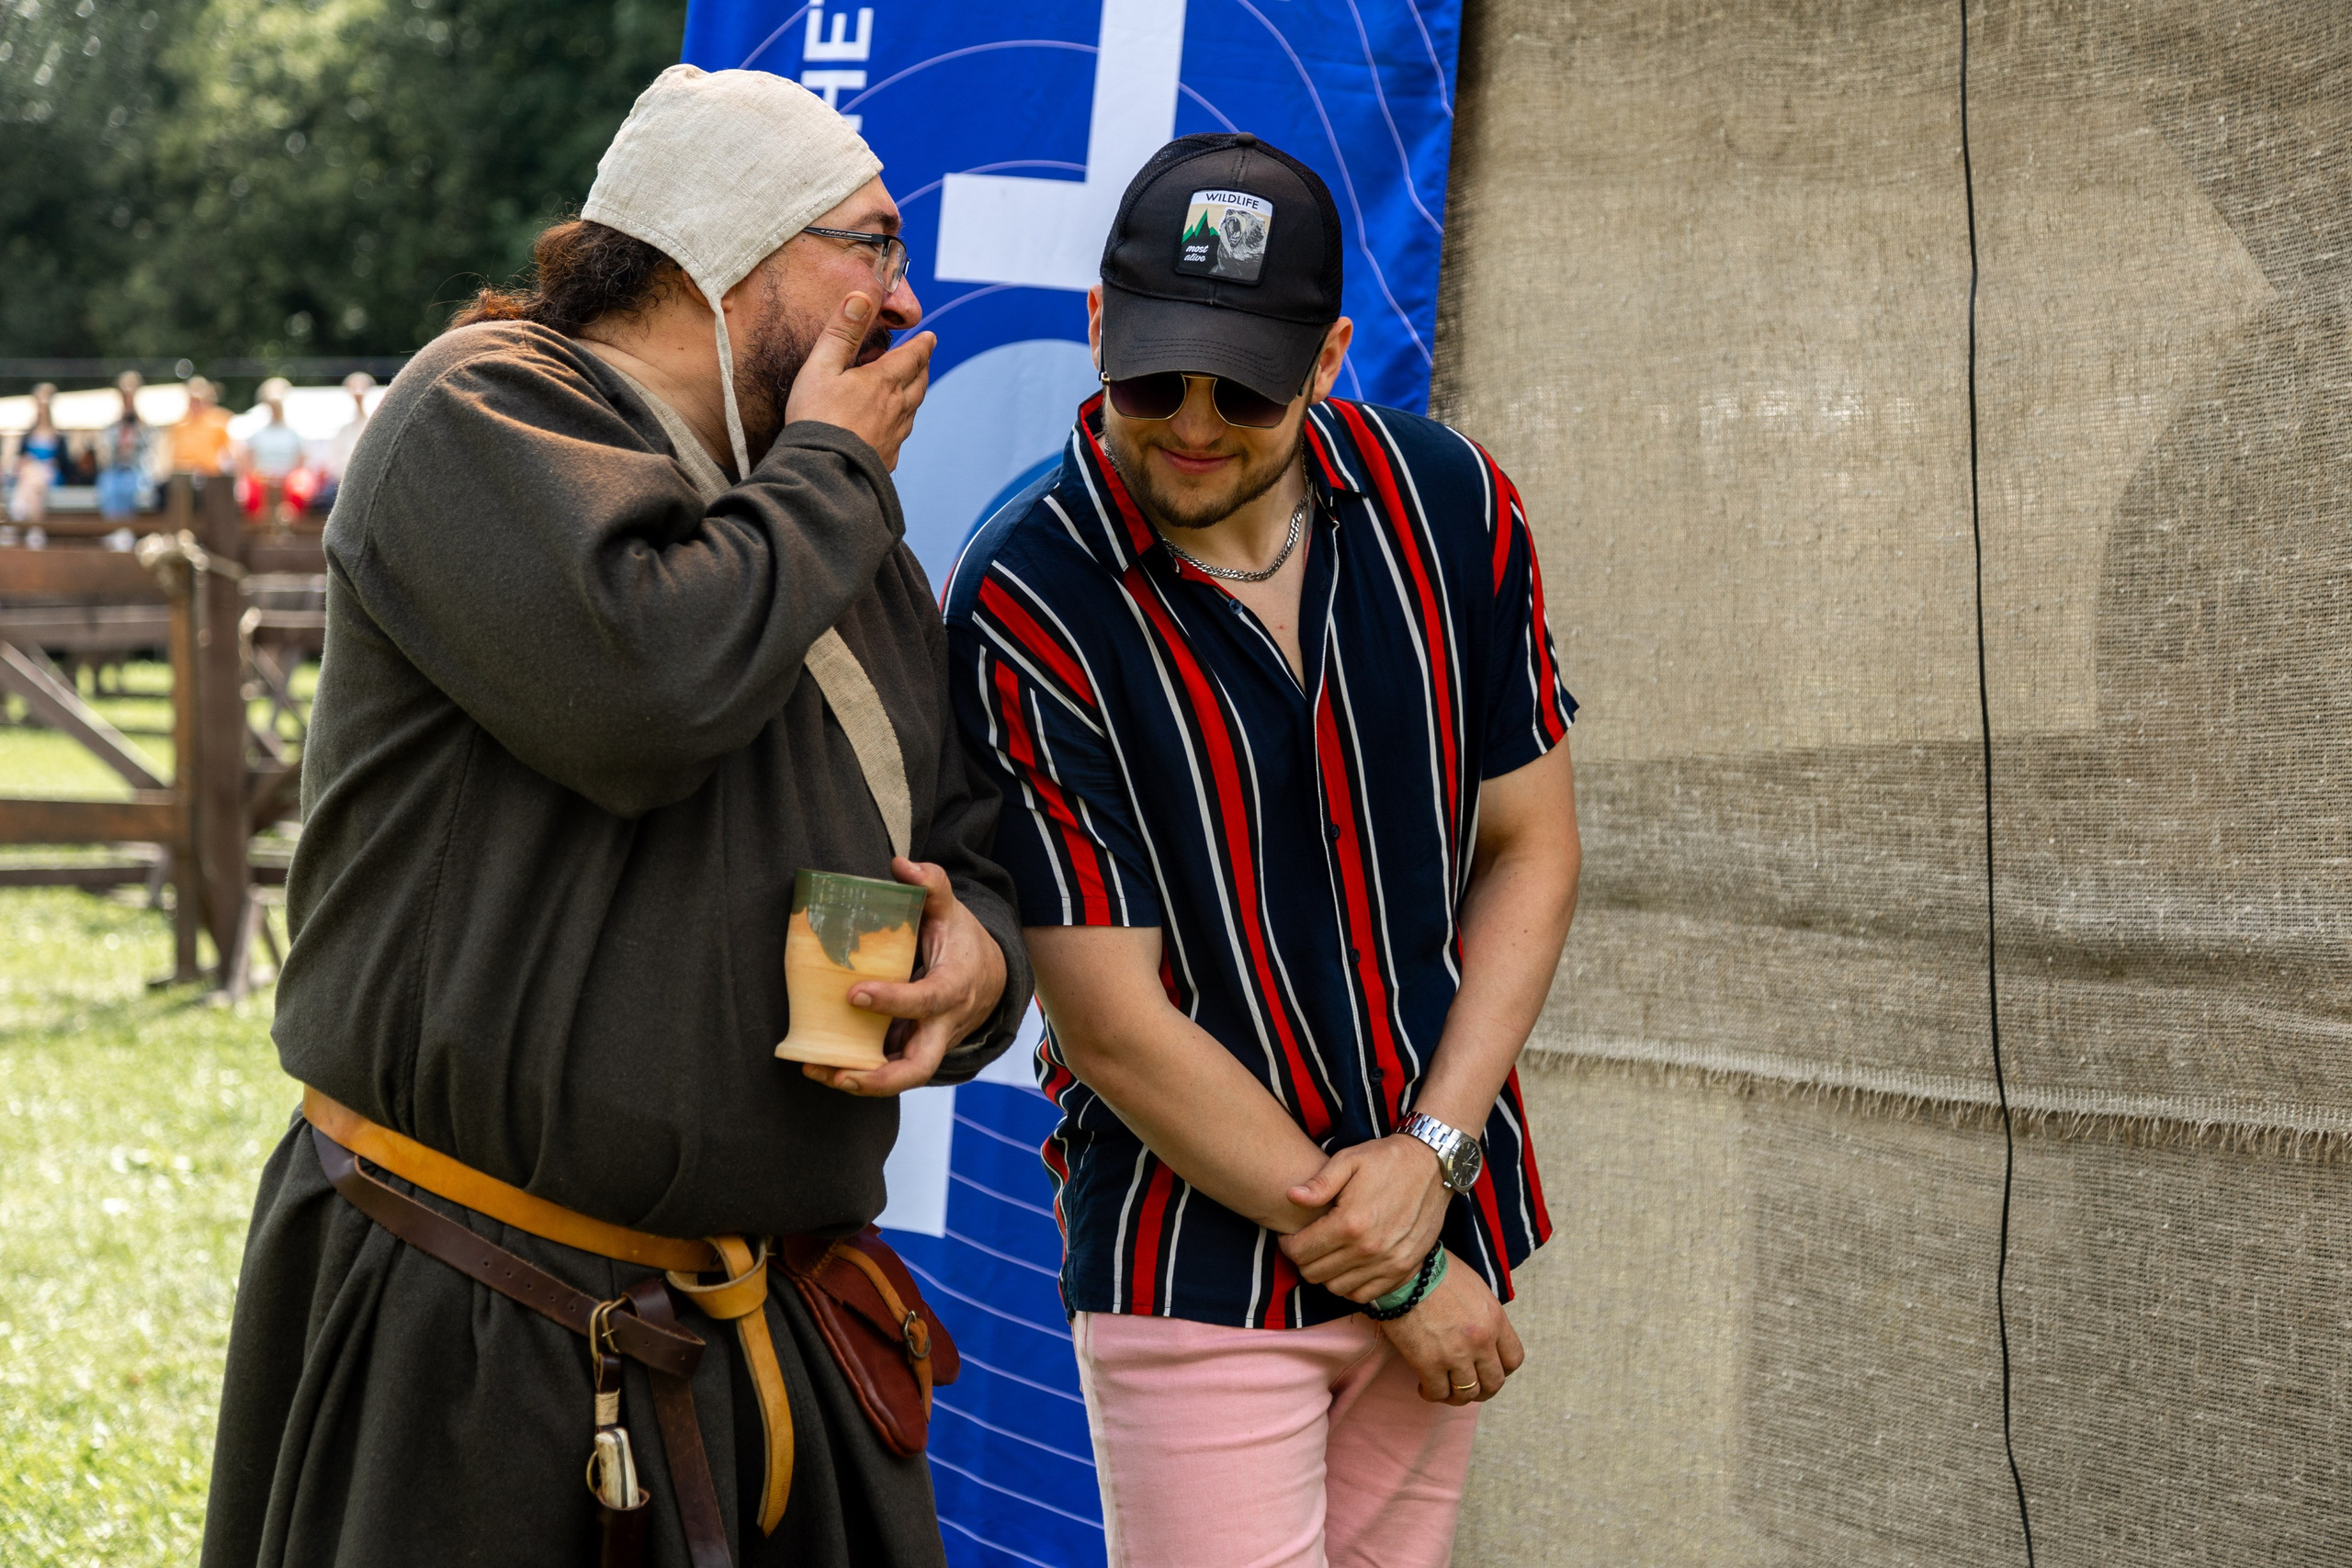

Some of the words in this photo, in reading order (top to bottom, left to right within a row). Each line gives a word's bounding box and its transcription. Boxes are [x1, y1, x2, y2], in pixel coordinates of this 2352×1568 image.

[800, 0, 874, 135] HE
[1205, 193, 1260, 209] WILDLIFE
[1185, 244, 1209, 254] most
[1183, 253, 1206, 262] alive
